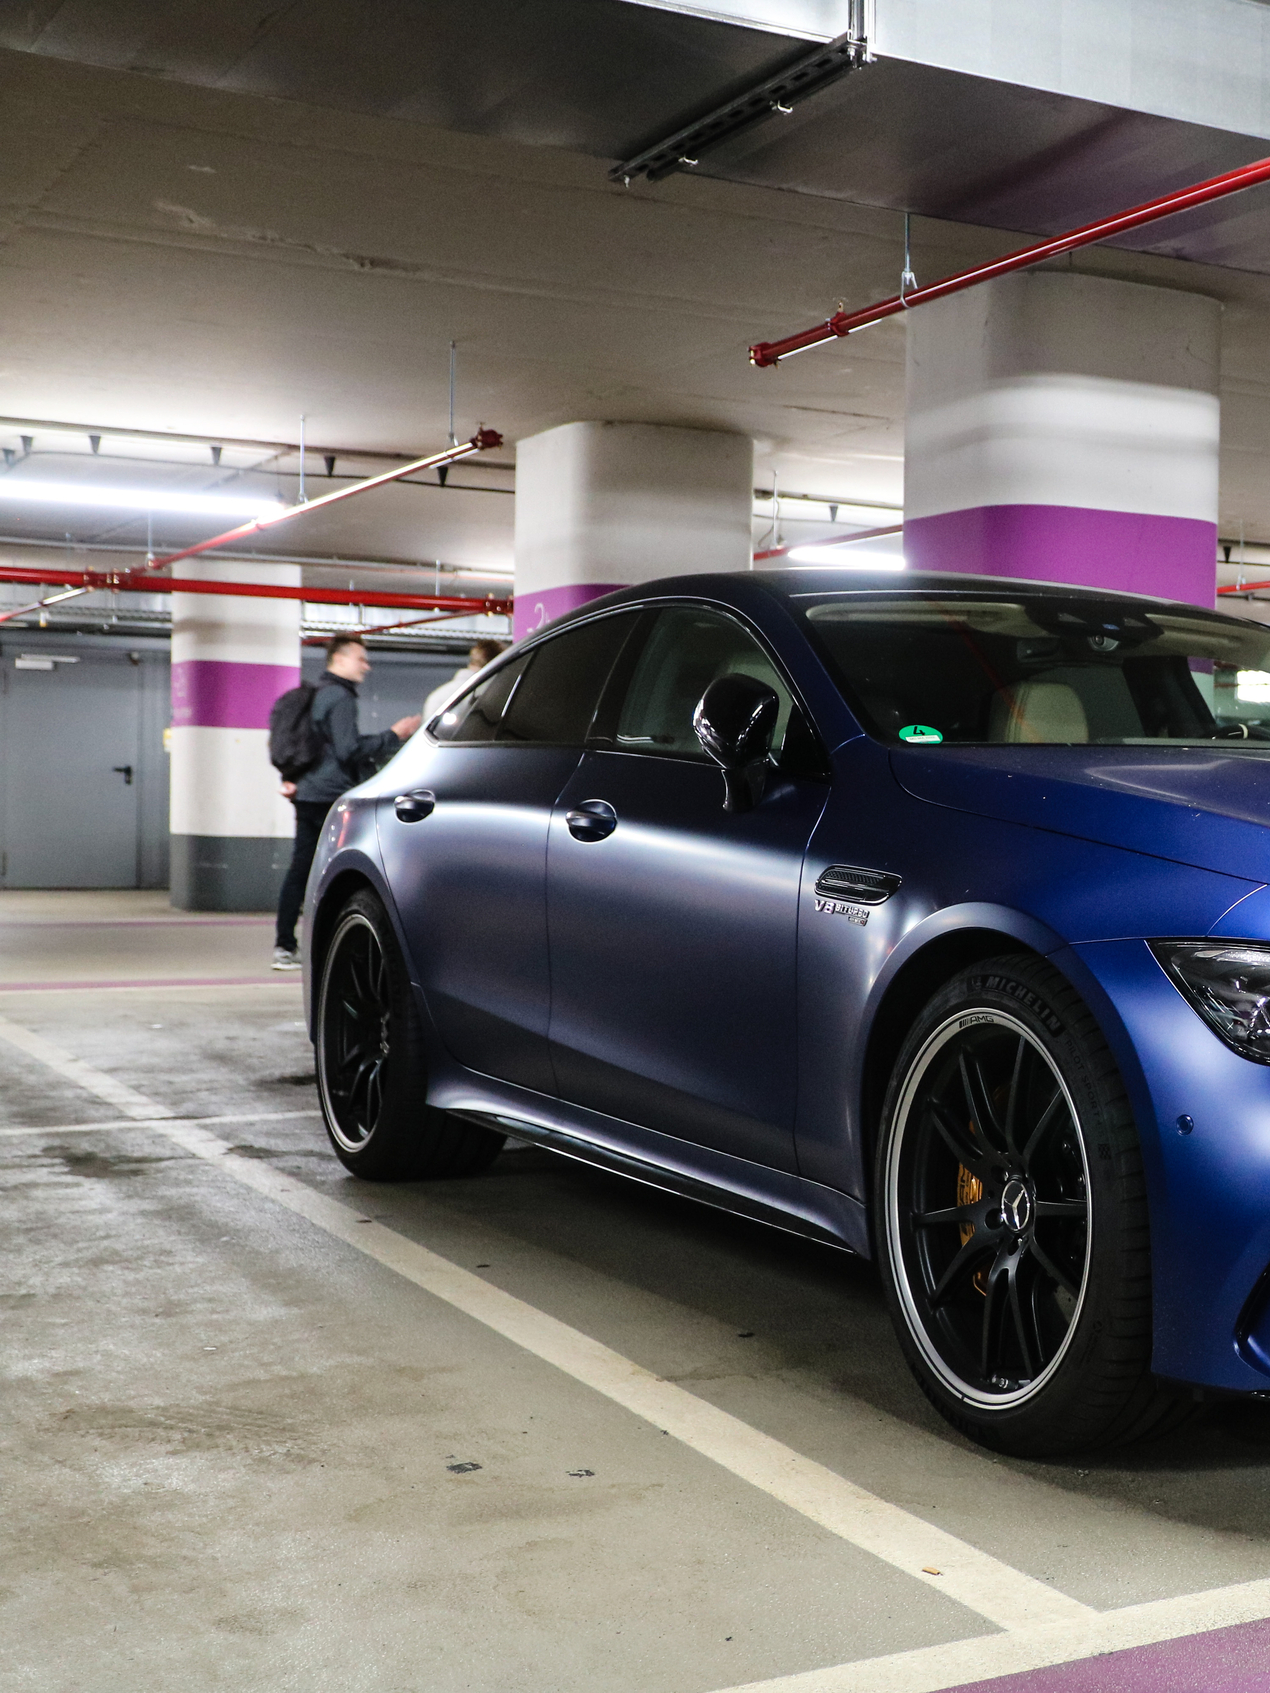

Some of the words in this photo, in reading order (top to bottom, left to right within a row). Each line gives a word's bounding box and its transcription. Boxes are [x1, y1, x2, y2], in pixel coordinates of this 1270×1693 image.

[912, 725, 925, 736] 4
[814, 899, 835, 915] V8
[985, 975, 1062, 1032] MICHELIN
[969, 1014, 994, 1024] AMG
[1065, 1040, 1085, 1071] PILOT
